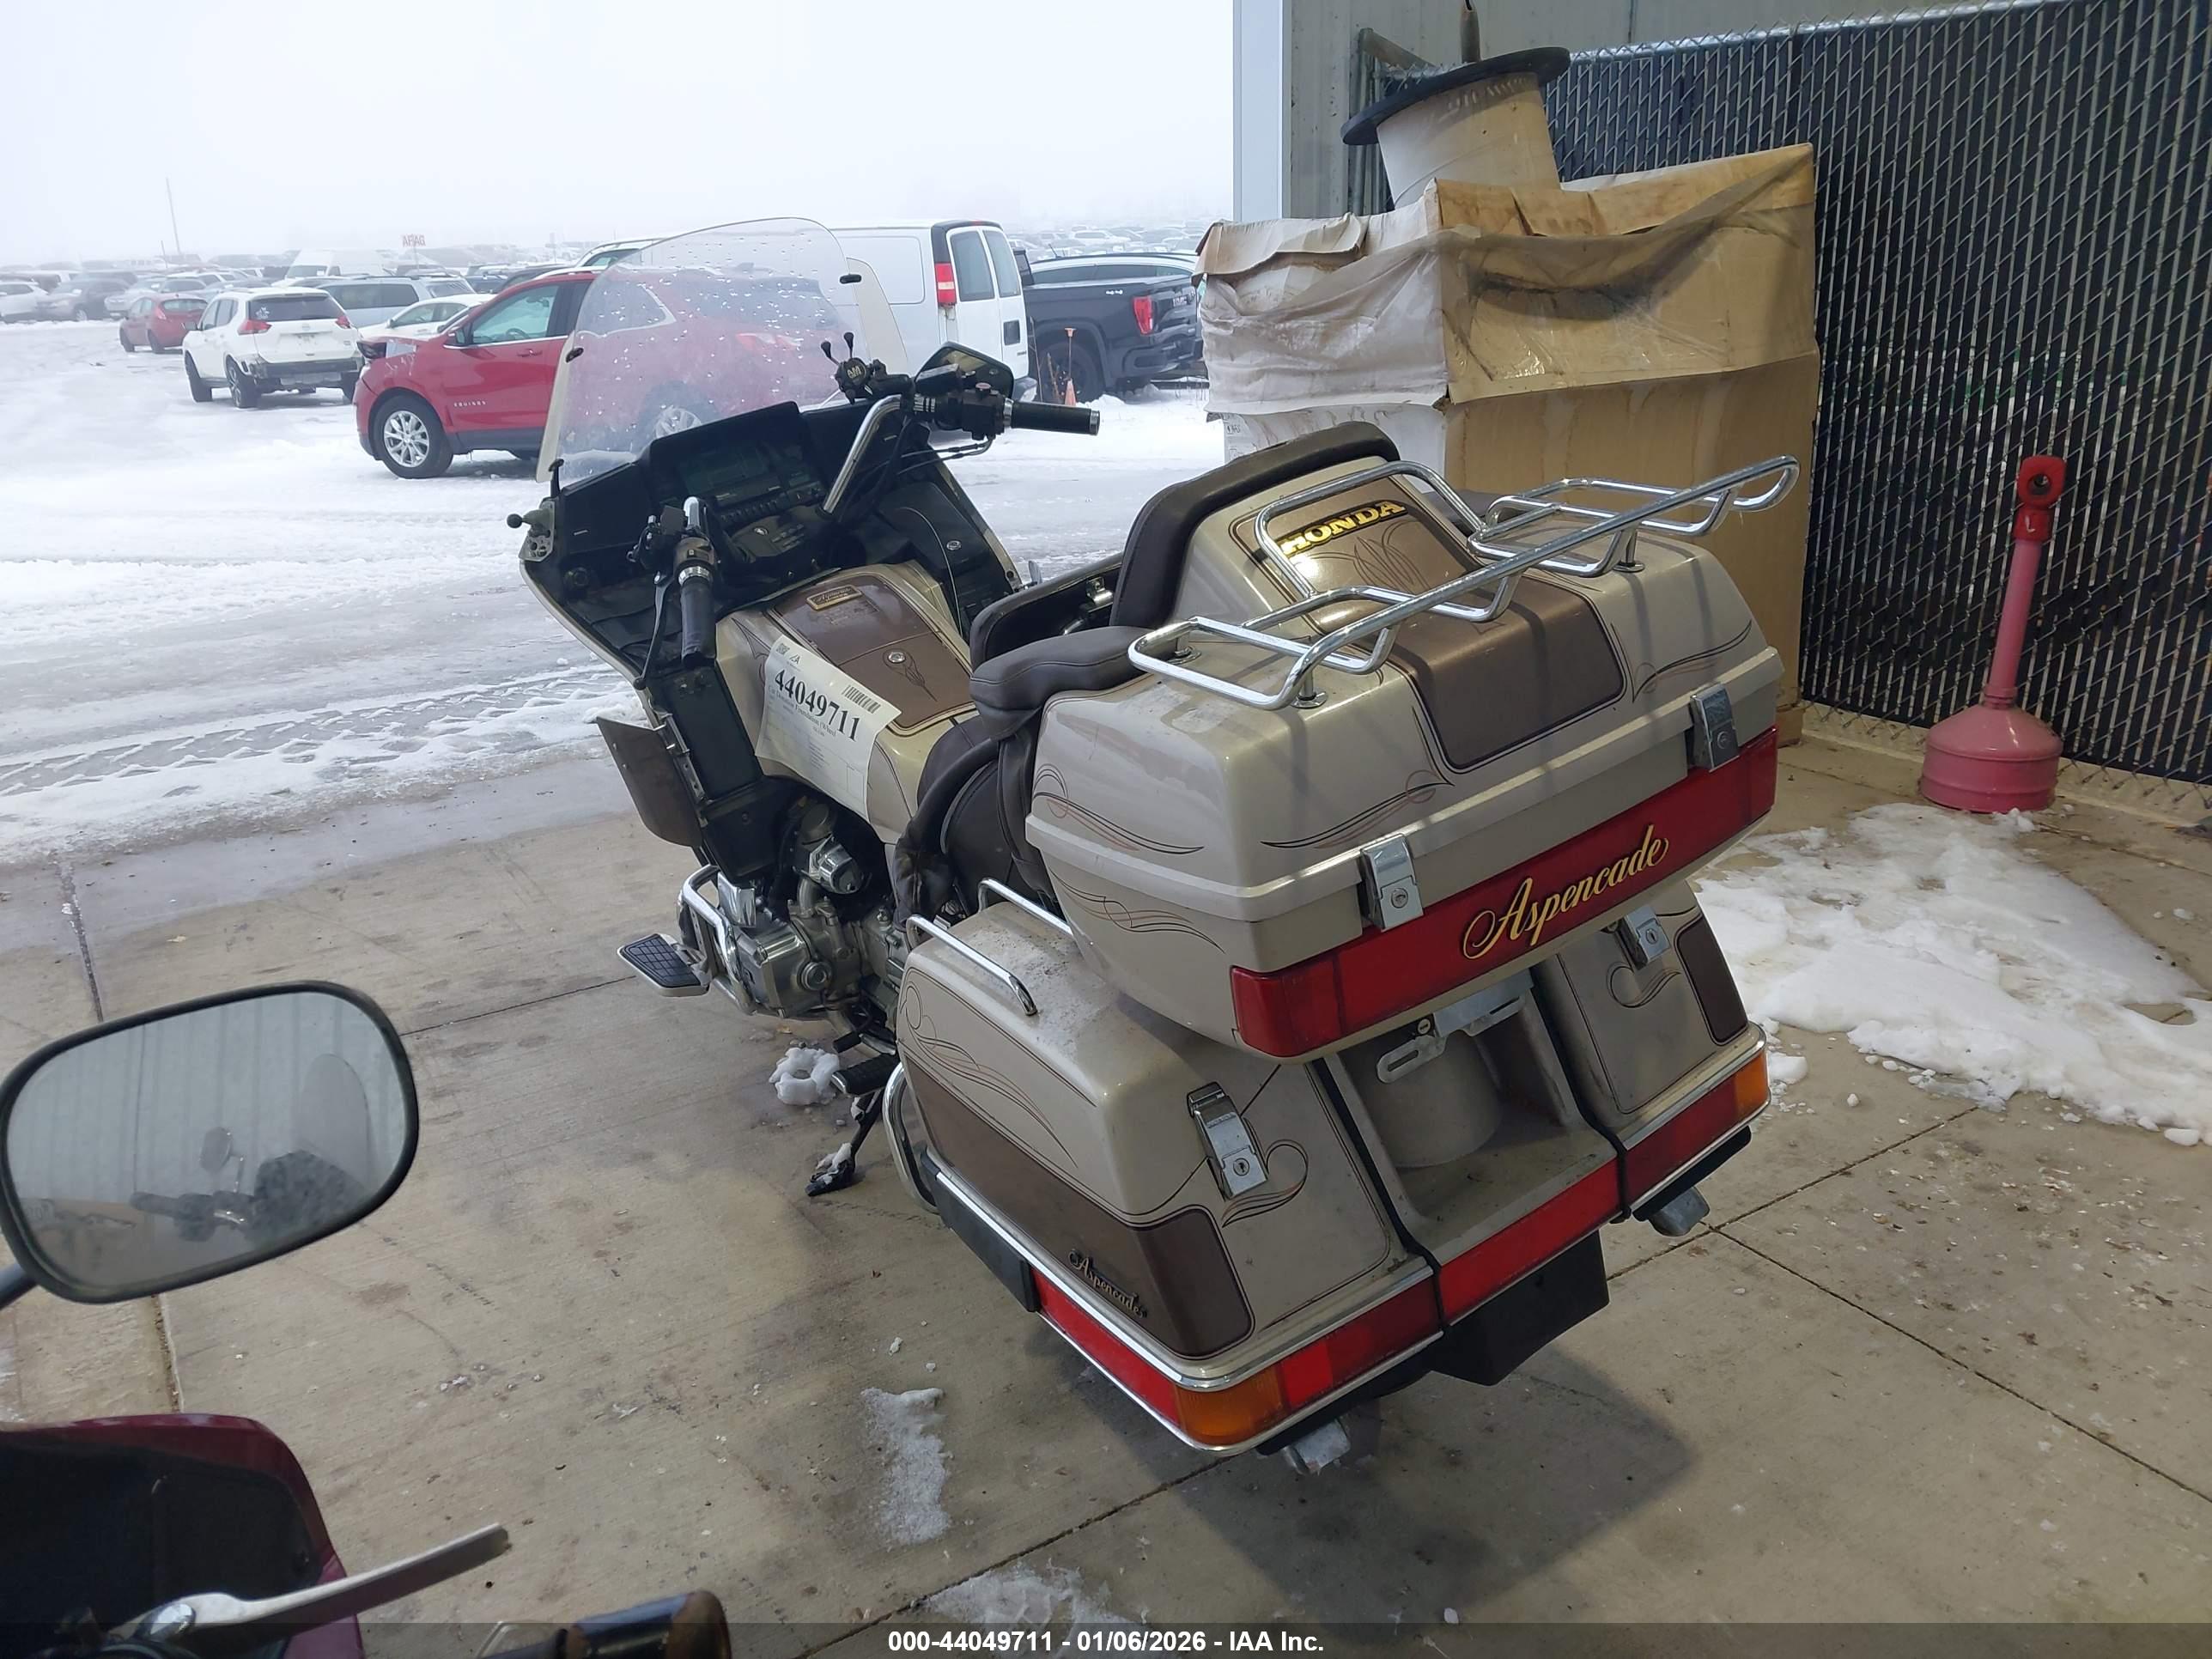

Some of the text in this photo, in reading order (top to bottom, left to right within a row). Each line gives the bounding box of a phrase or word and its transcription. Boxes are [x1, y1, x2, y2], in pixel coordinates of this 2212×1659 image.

[1279, 501, 1406, 556] HONDA
[775, 670, 860, 742] 44049711
[1463, 824, 1669, 959] Aspencade
[1068, 1249, 1146, 1318] Aspencade
